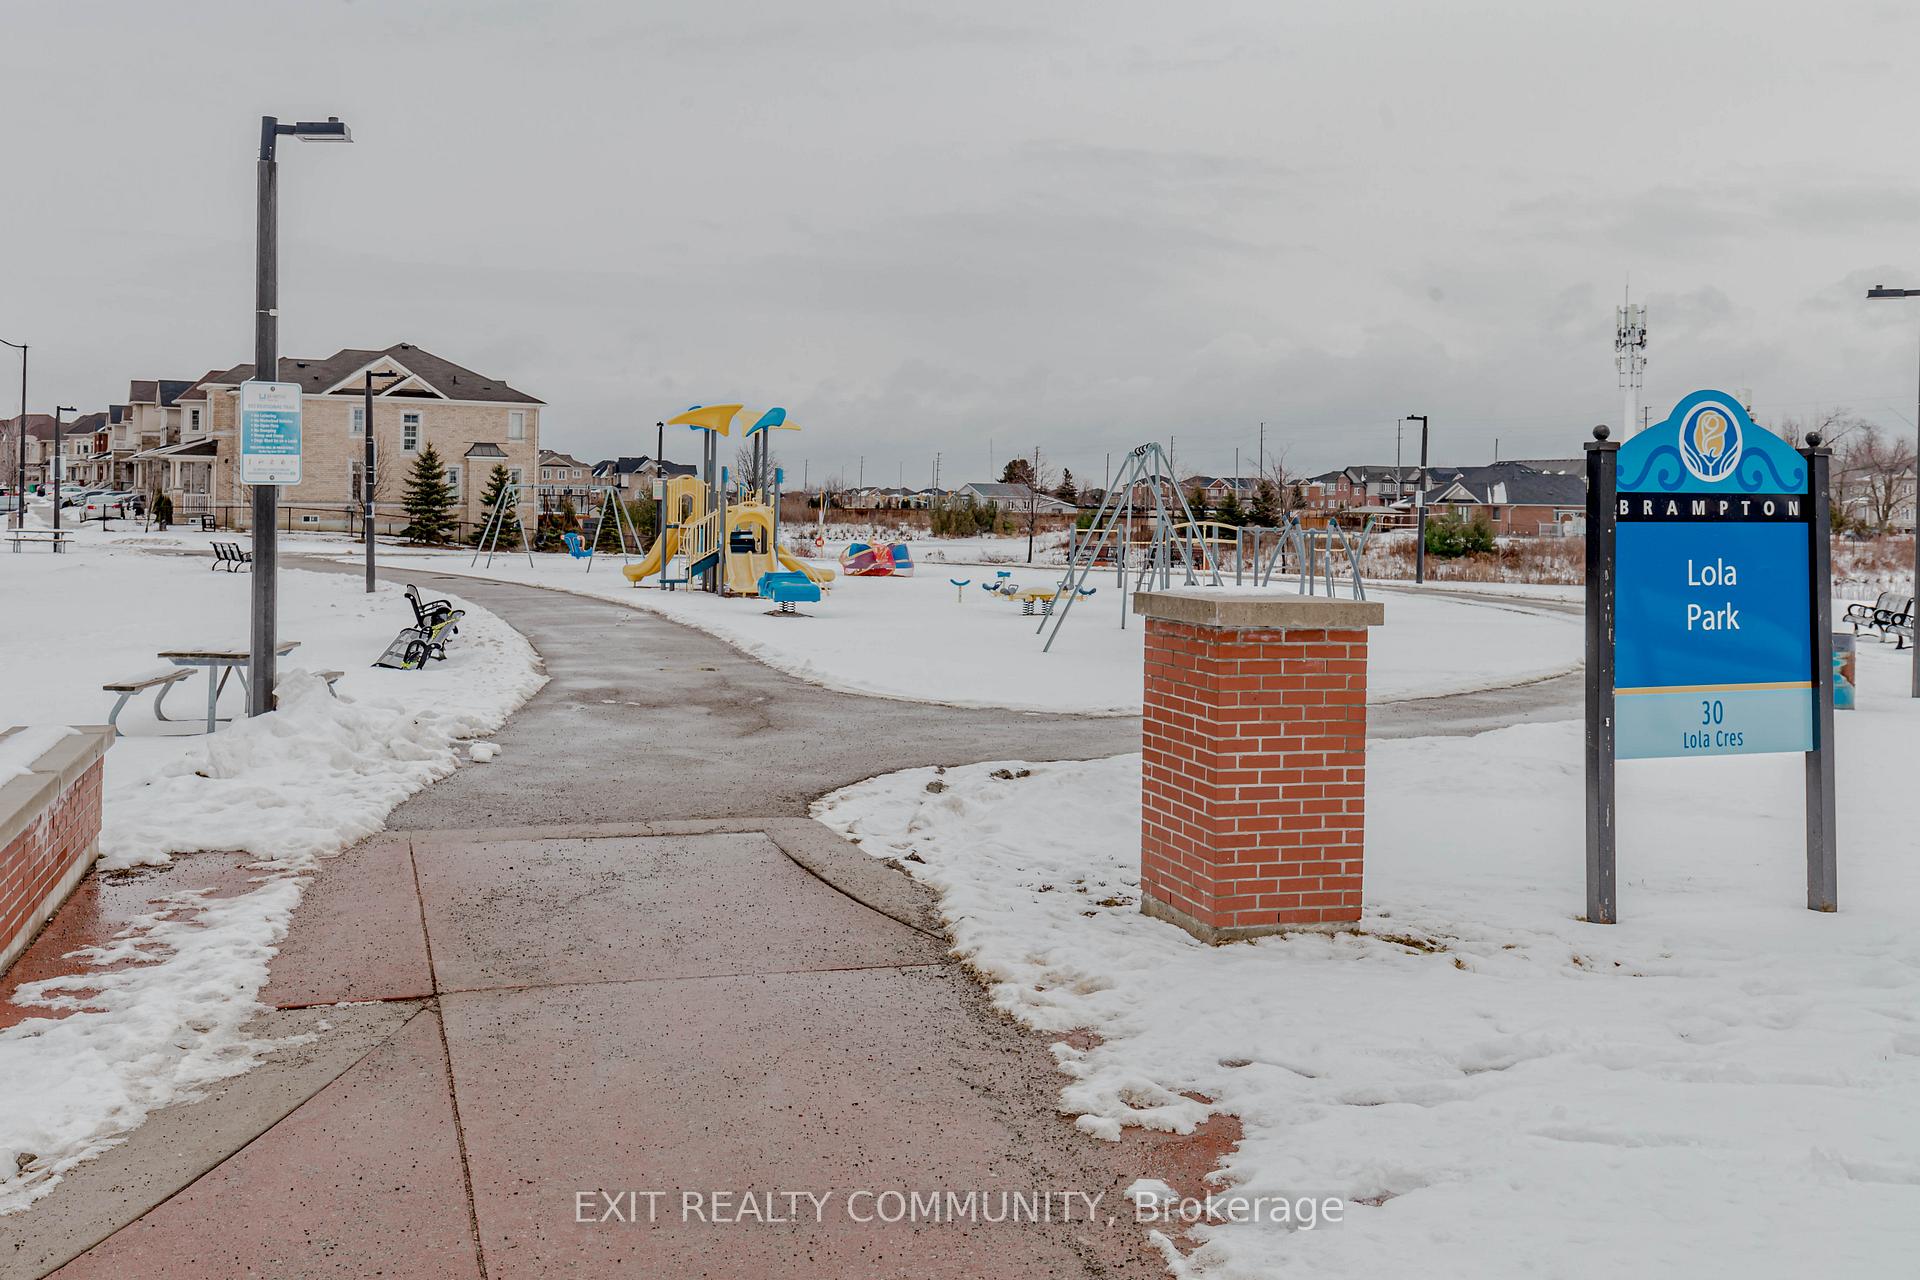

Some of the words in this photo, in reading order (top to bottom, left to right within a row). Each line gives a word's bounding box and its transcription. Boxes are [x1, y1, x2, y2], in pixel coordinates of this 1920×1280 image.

[1619, 499, 1800, 517] BRAMPTON
[1687, 558, 1738, 586] Lola
[1687, 602, 1741, 631] Park
[1702, 700, 1724, 725] 30
[1683, 730, 1710, 749] Lola
[1716, 730, 1744, 747] Cres
